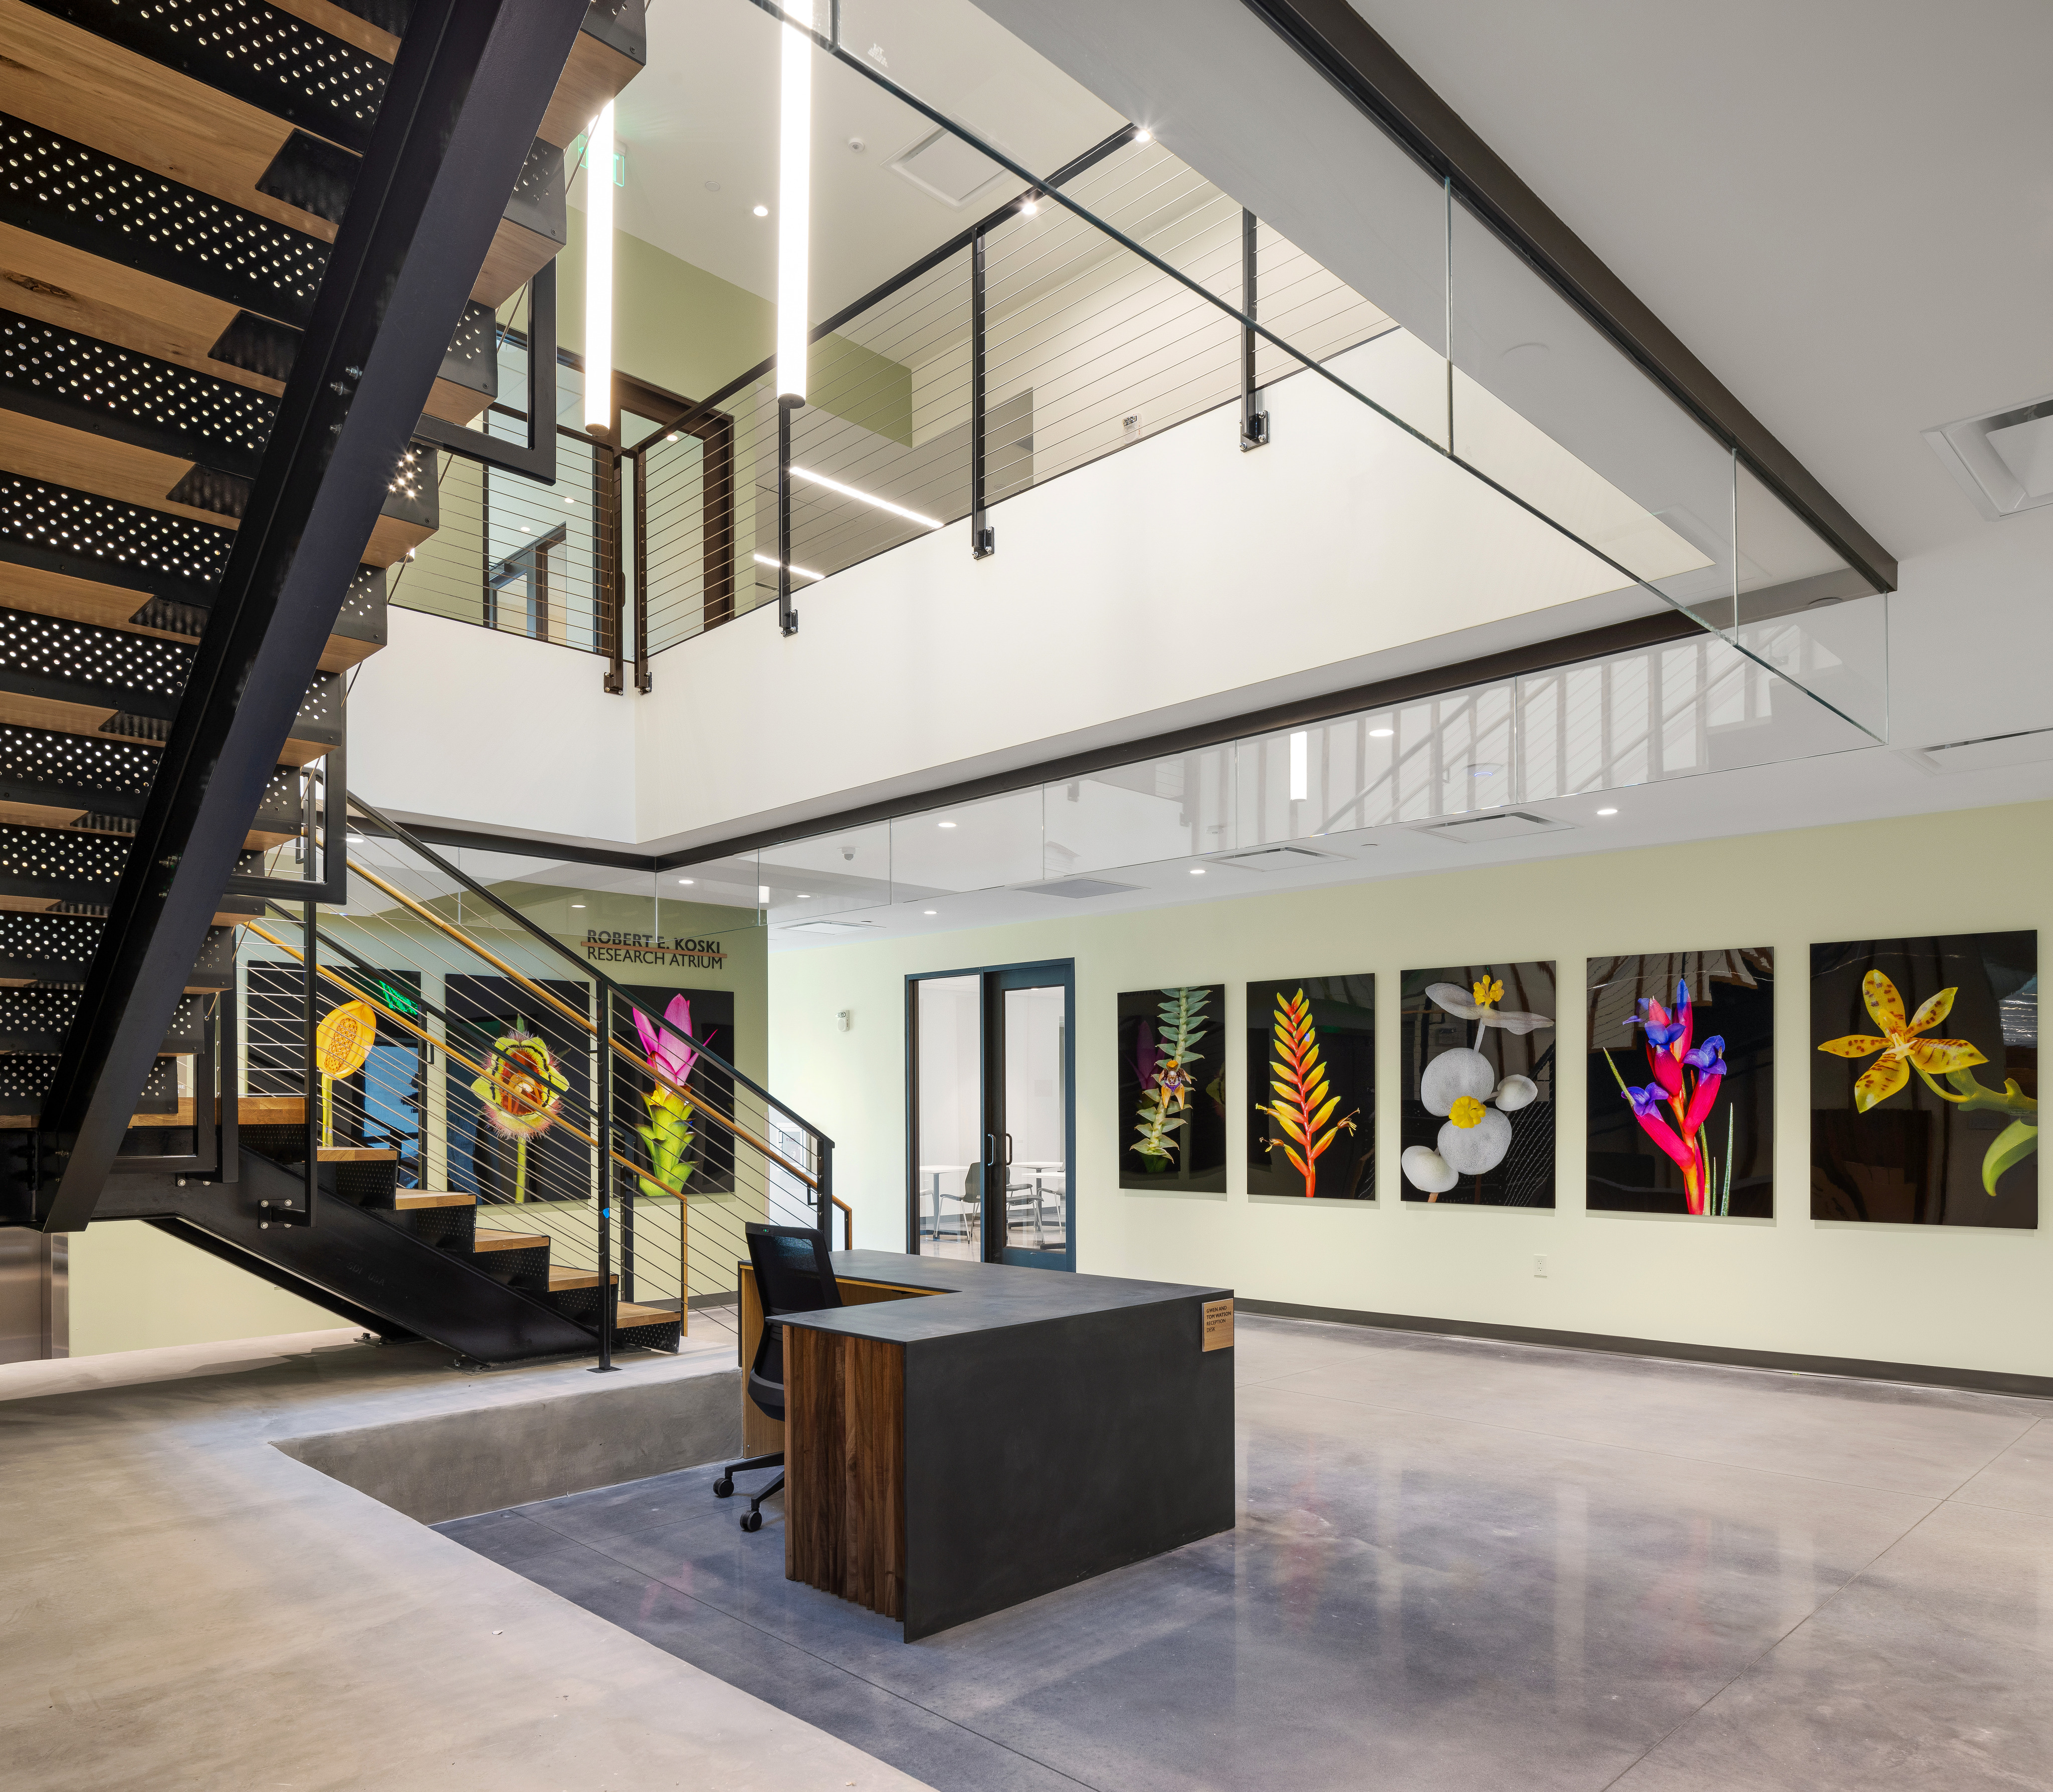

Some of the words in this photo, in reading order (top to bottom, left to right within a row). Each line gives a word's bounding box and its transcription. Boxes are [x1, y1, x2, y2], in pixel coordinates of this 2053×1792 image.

[587, 930, 653, 947] ROBERT
[658, 936, 670, 949] E.
[675, 938, 720, 954] KOSKI
[587, 946, 665, 965] RESEARCH
[670, 953, 722, 969] ATRIUM
